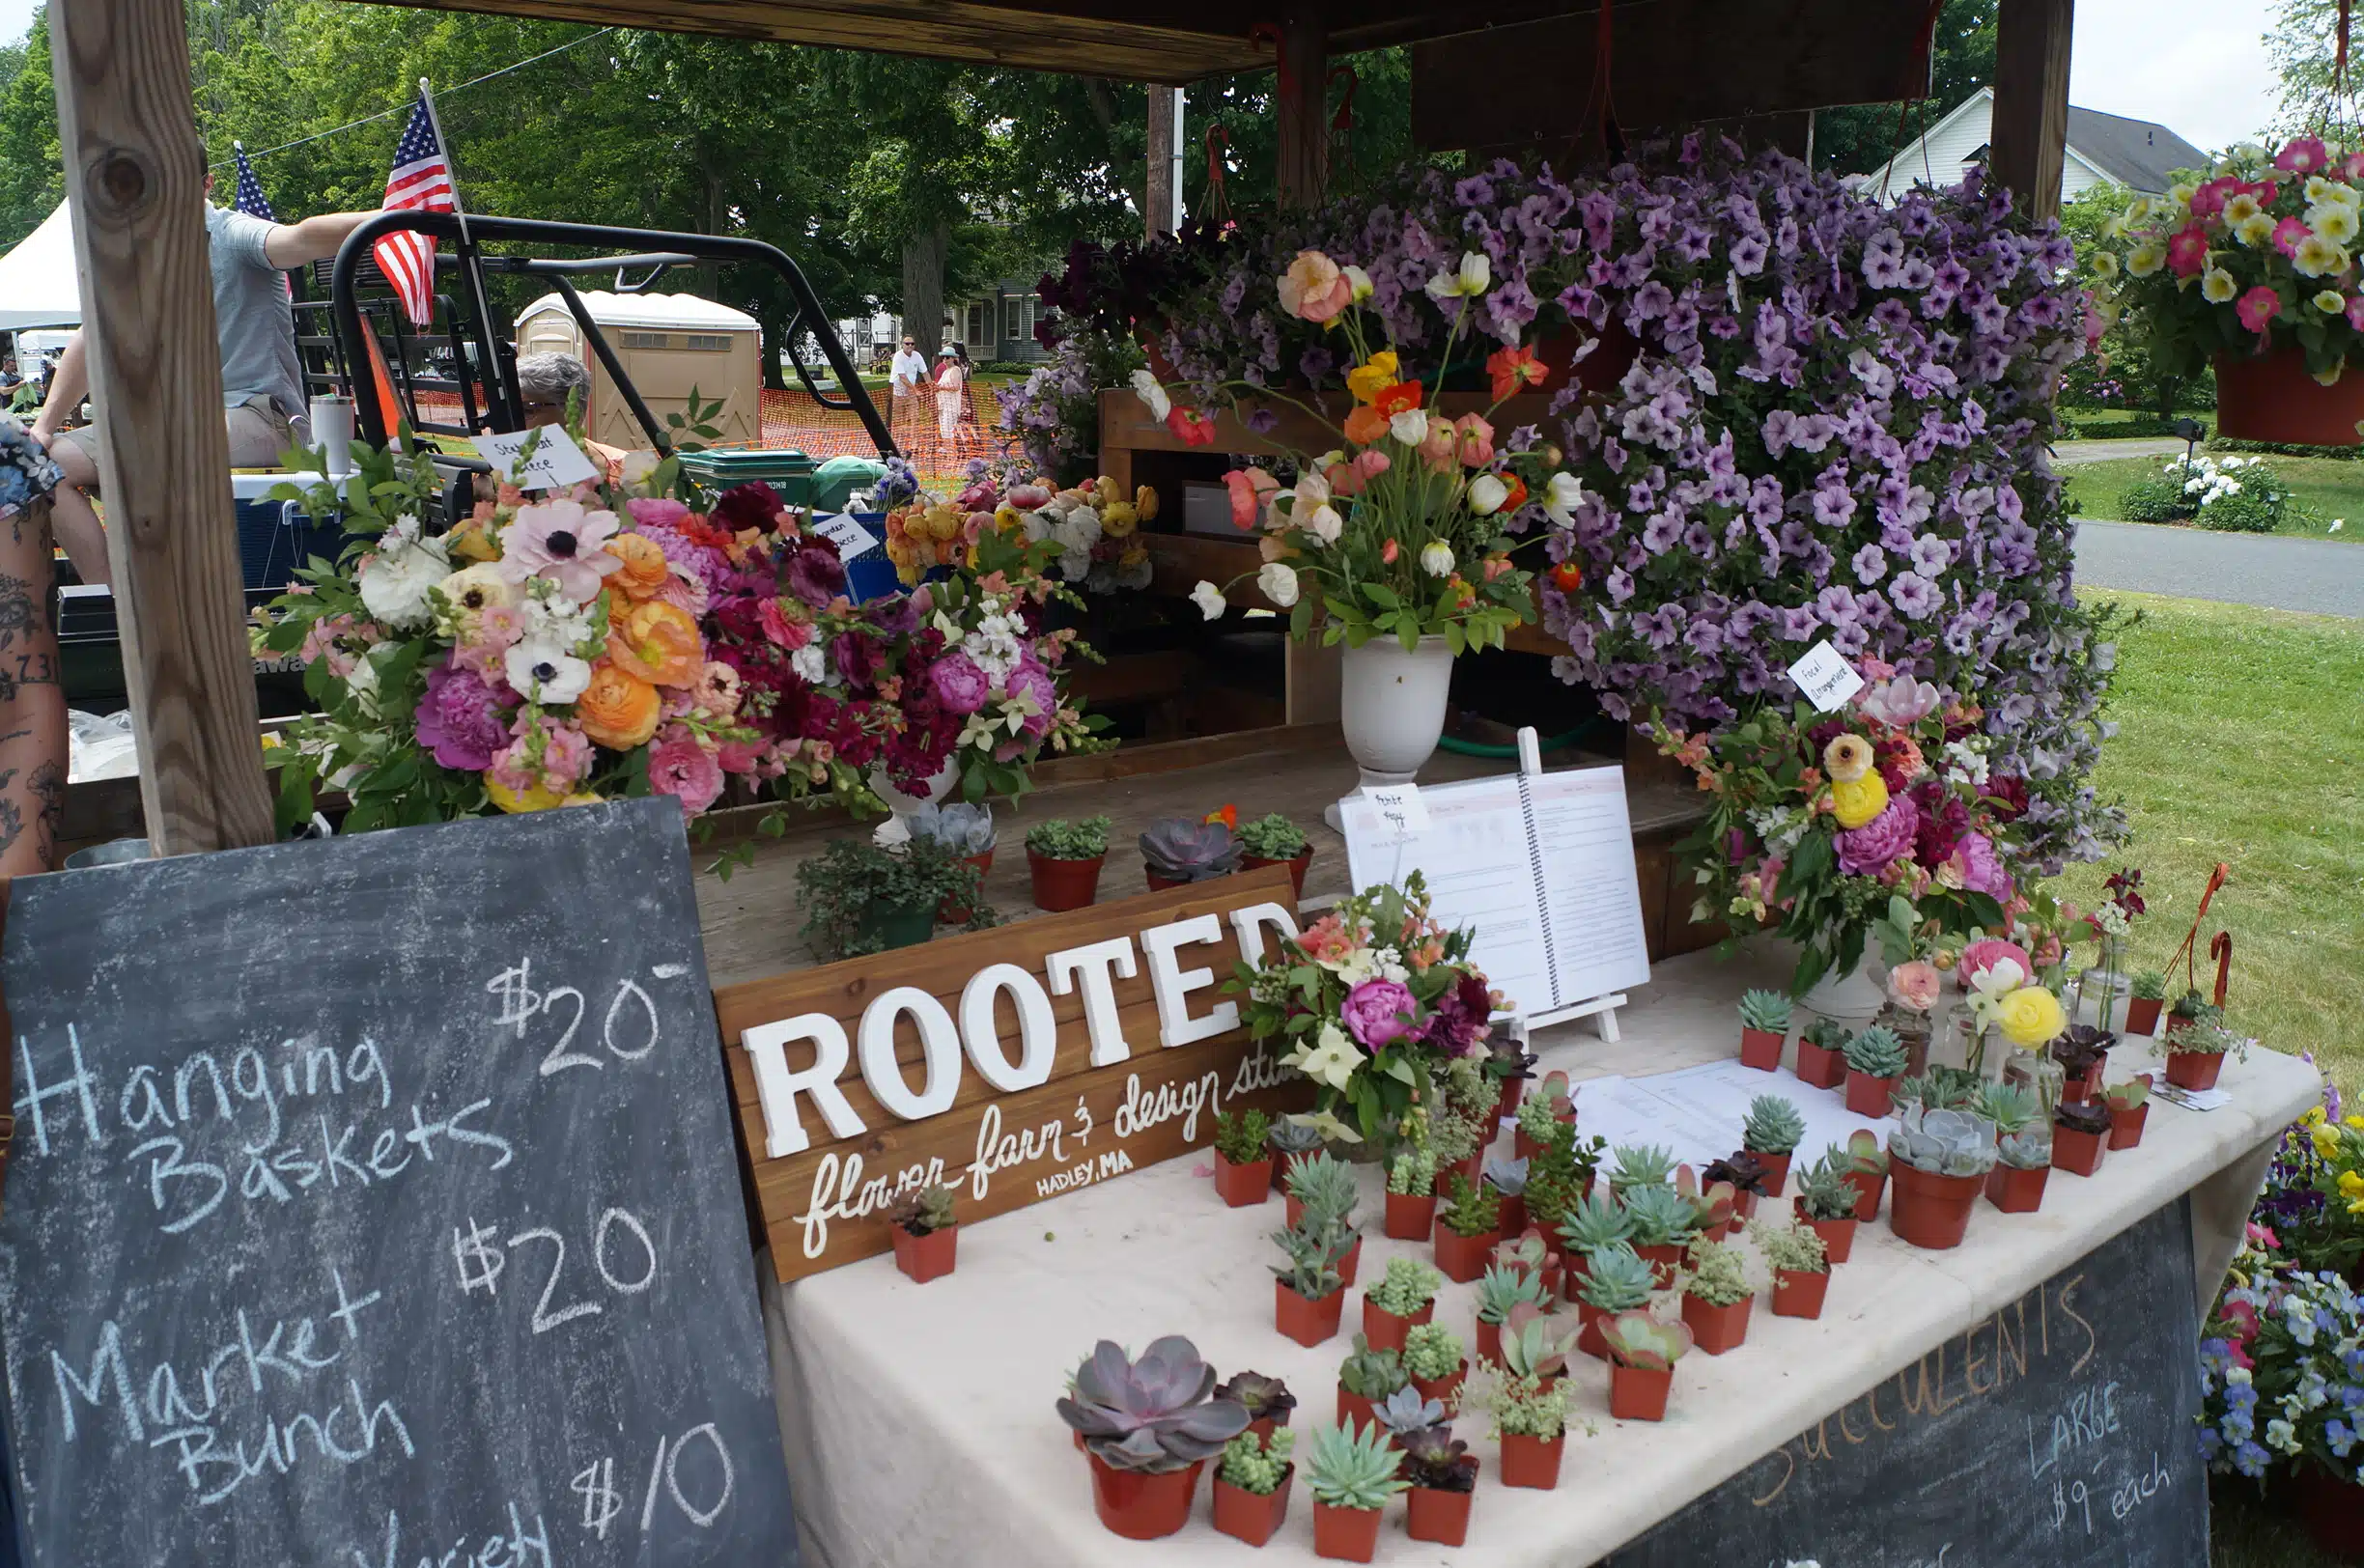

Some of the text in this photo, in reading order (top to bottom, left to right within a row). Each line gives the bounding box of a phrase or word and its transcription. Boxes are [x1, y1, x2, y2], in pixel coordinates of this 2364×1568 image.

[493, 435, 553, 456] Statent
[519, 458, 554, 471] iece
[819, 522, 846, 538] arden
[1801, 659, 1822, 681] Focal
[13, 1022, 392, 1157] Hanging
[966, 1104, 1071, 1201] farm
[1114, 1074, 1222, 1143] design
[1224, 1036, 1302, 1102] stu
[127, 1097, 513, 1235] Baskets
[451, 1206, 658, 1336] $20
[50, 1267, 380, 1443] Market
[150, 1379, 415, 1505] Bunch
[570, 1421, 735, 1543] $10
[2027, 1381, 2121, 1480] LARGE
[2111, 1451, 2170, 1521] each
